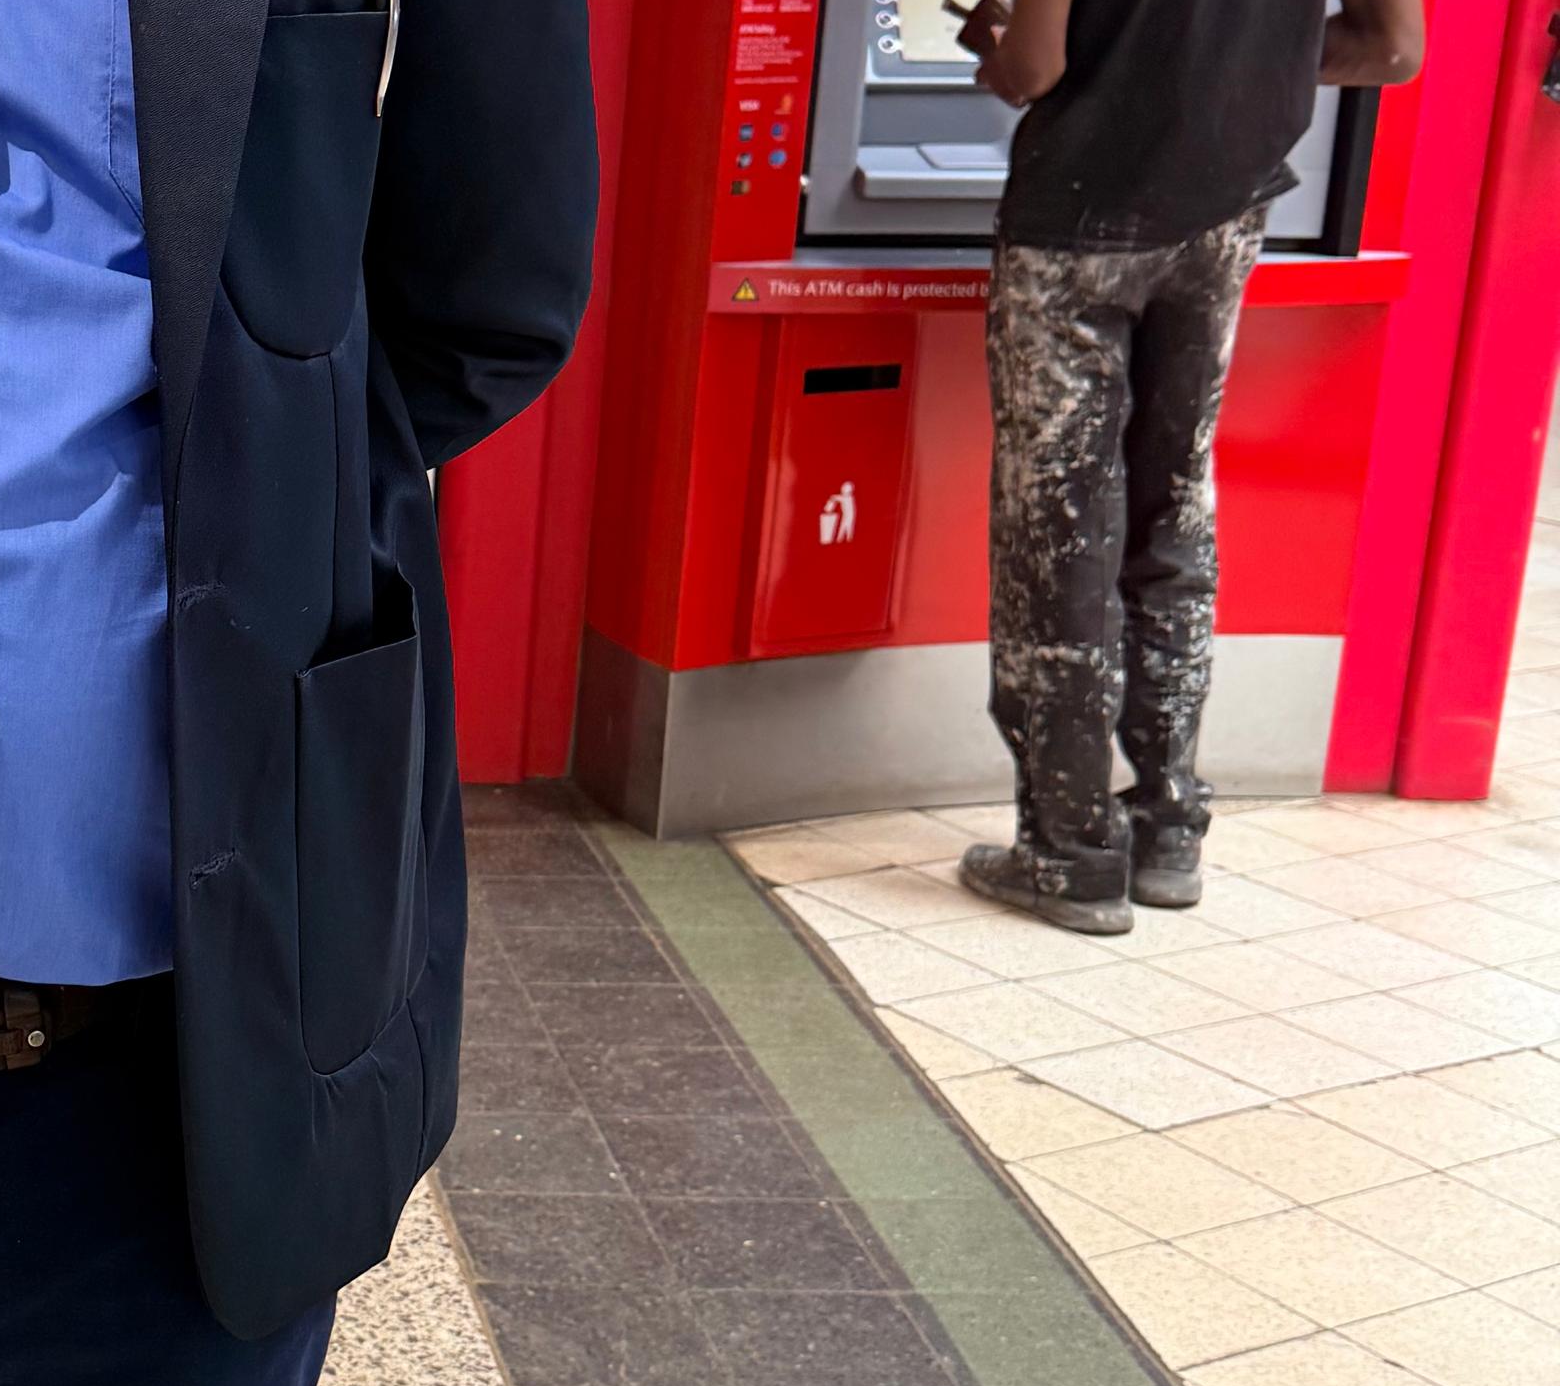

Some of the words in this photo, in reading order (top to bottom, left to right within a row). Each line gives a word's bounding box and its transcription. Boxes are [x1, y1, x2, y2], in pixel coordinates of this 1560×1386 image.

[768, 280, 800, 297] This
[804, 281, 842, 297] ATM
[846, 281, 882, 297] cash
[887, 281, 899, 297] is
[902, 281, 976, 300] protected
